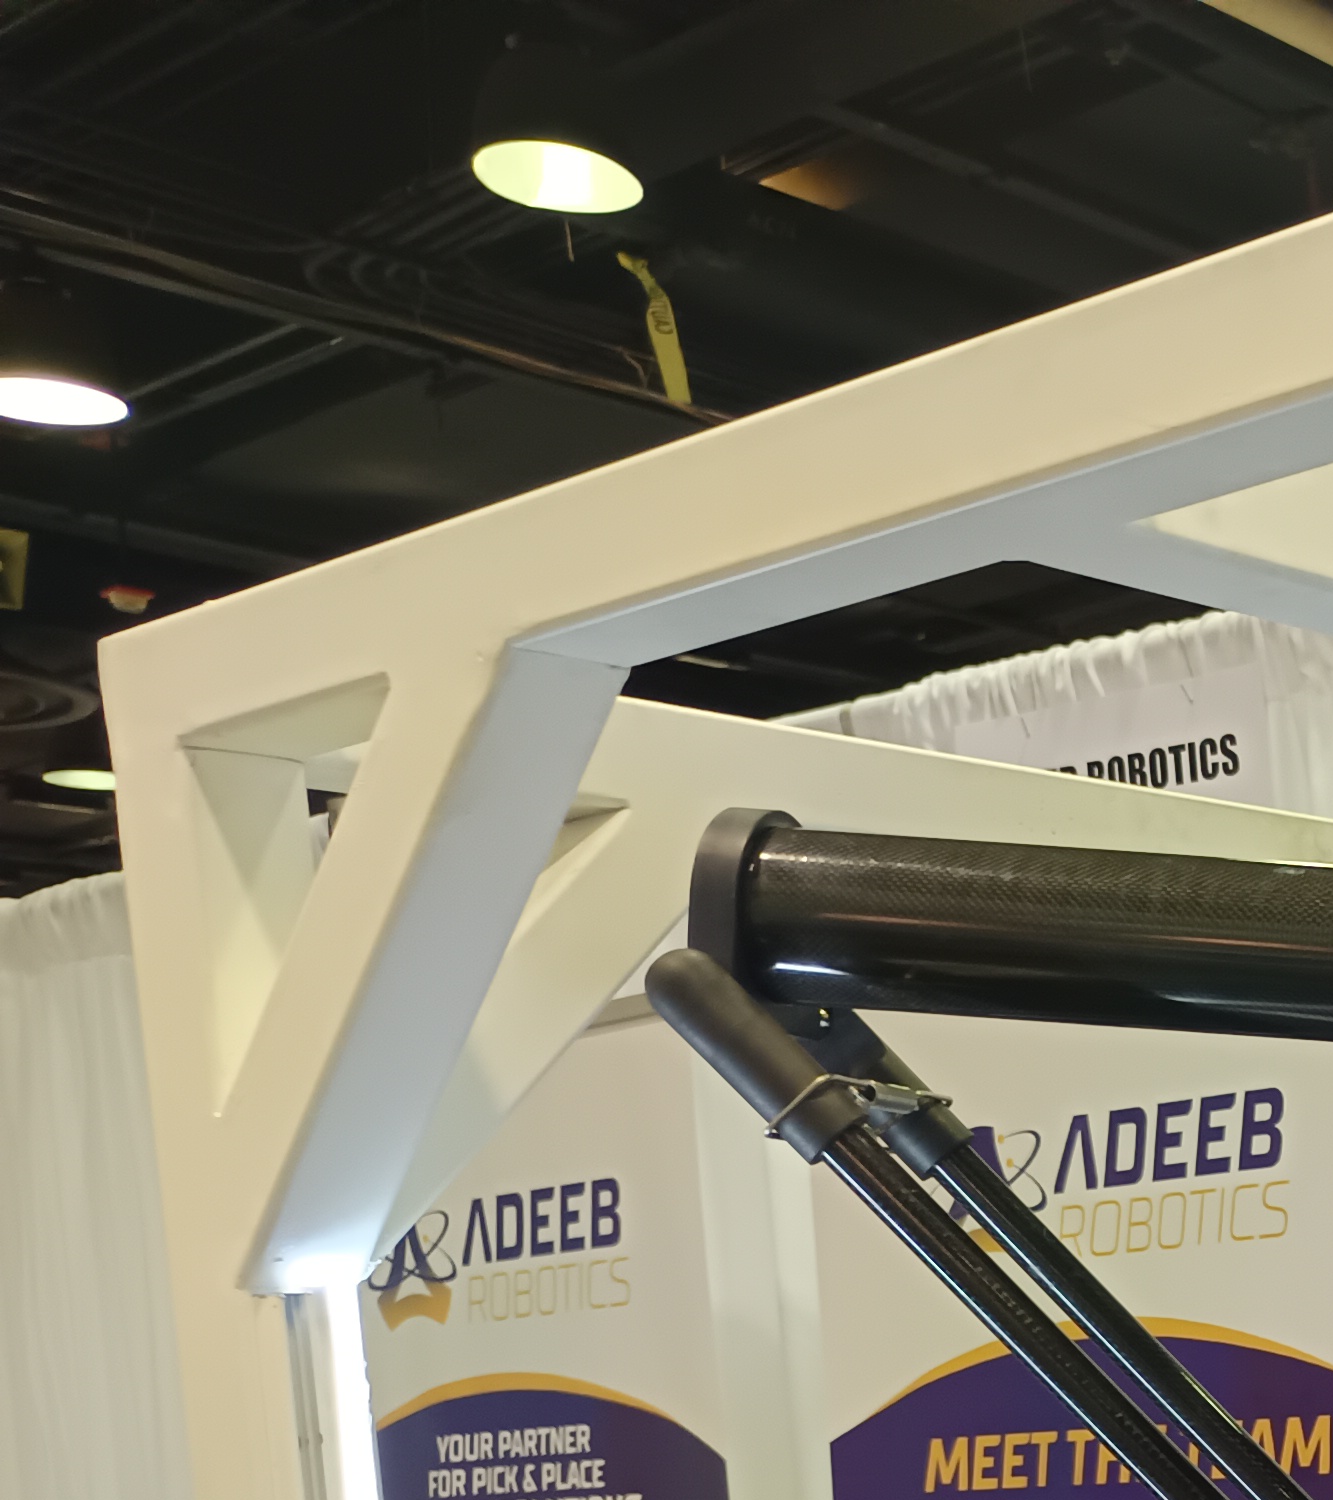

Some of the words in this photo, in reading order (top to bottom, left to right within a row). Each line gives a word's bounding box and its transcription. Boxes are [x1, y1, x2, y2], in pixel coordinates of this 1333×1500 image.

[1054, 1087, 1284, 1195] ADEEB
[462, 1177, 621, 1267] ADEEB
[1060, 1179, 1290, 1258] ROBOTICS
[468, 1256, 631, 1324] ROBOTICS
[436, 1431, 494, 1464] YOUR
[498, 1423, 591, 1460] PARTNER
[923, 1430, 1058, 1494] MEET
[428, 1468, 467, 1498] FOR
[472, 1464, 518, 1496] PICK
[522, 1463, 538, 1493] &
[541, 1458, 606, 1492] PLACE
